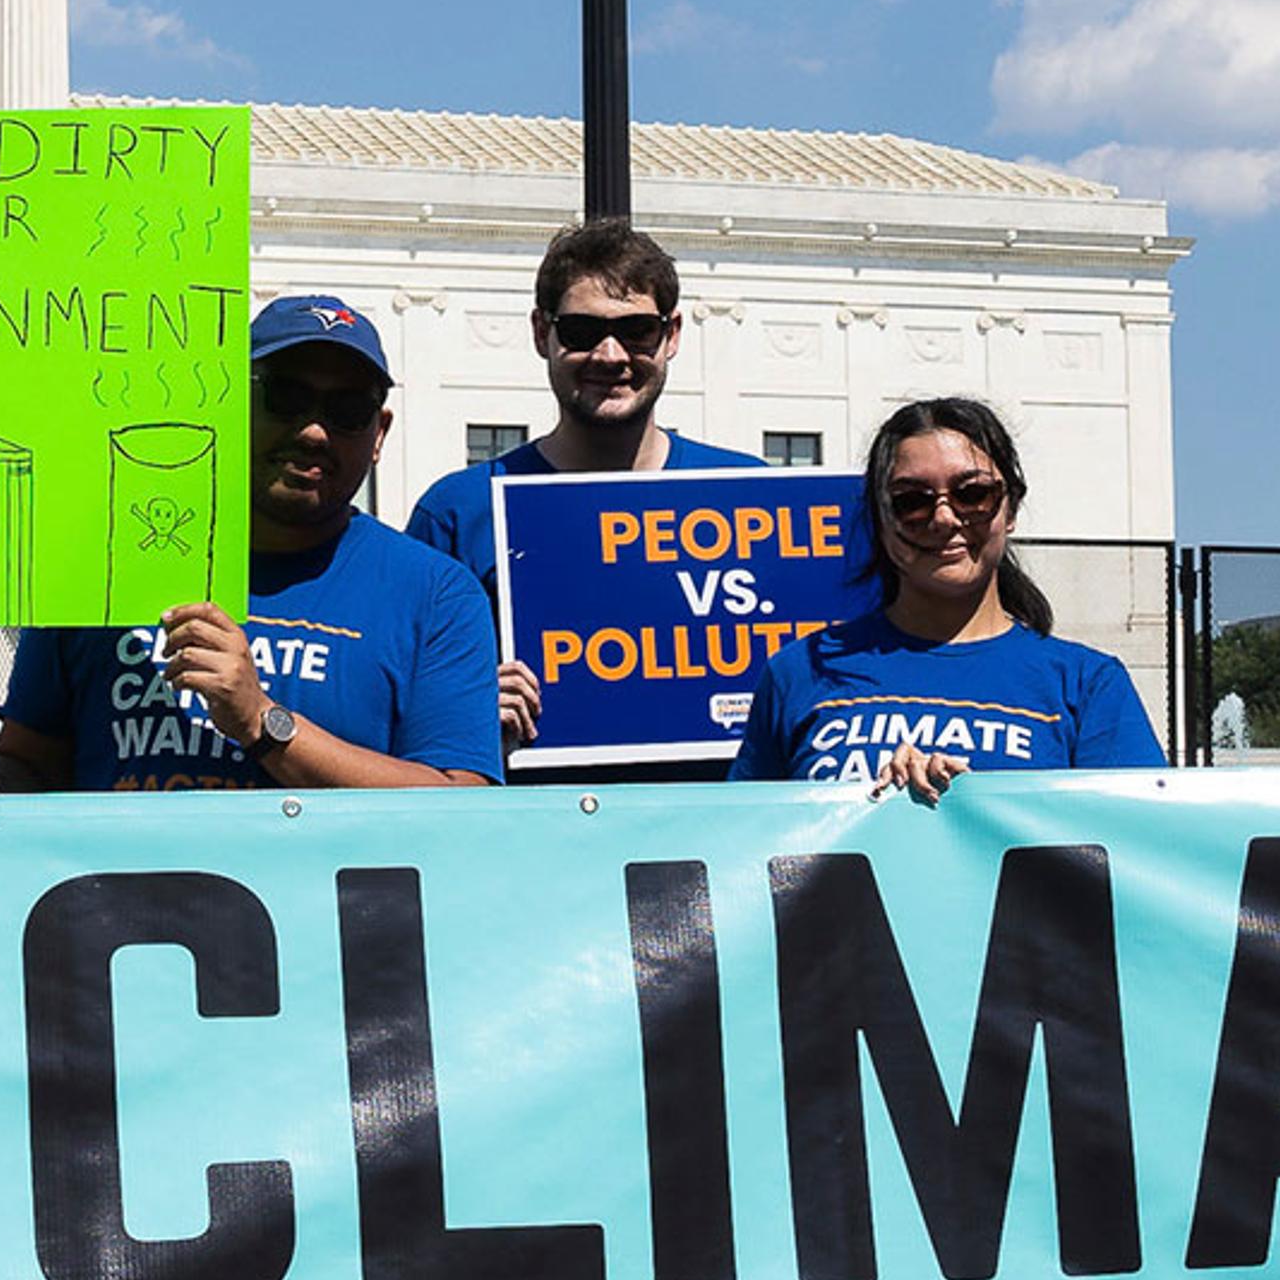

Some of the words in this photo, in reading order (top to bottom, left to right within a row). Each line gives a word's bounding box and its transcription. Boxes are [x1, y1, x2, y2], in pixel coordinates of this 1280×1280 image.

[598, 504, 845, 564] PEOPLE
[676, 568, 776, 617] VS.
[116, 628, 330, 682] CLATE
[540, 621, 845, 684] POLLUT
[811, 713, 1033, 760] CLIMATE
